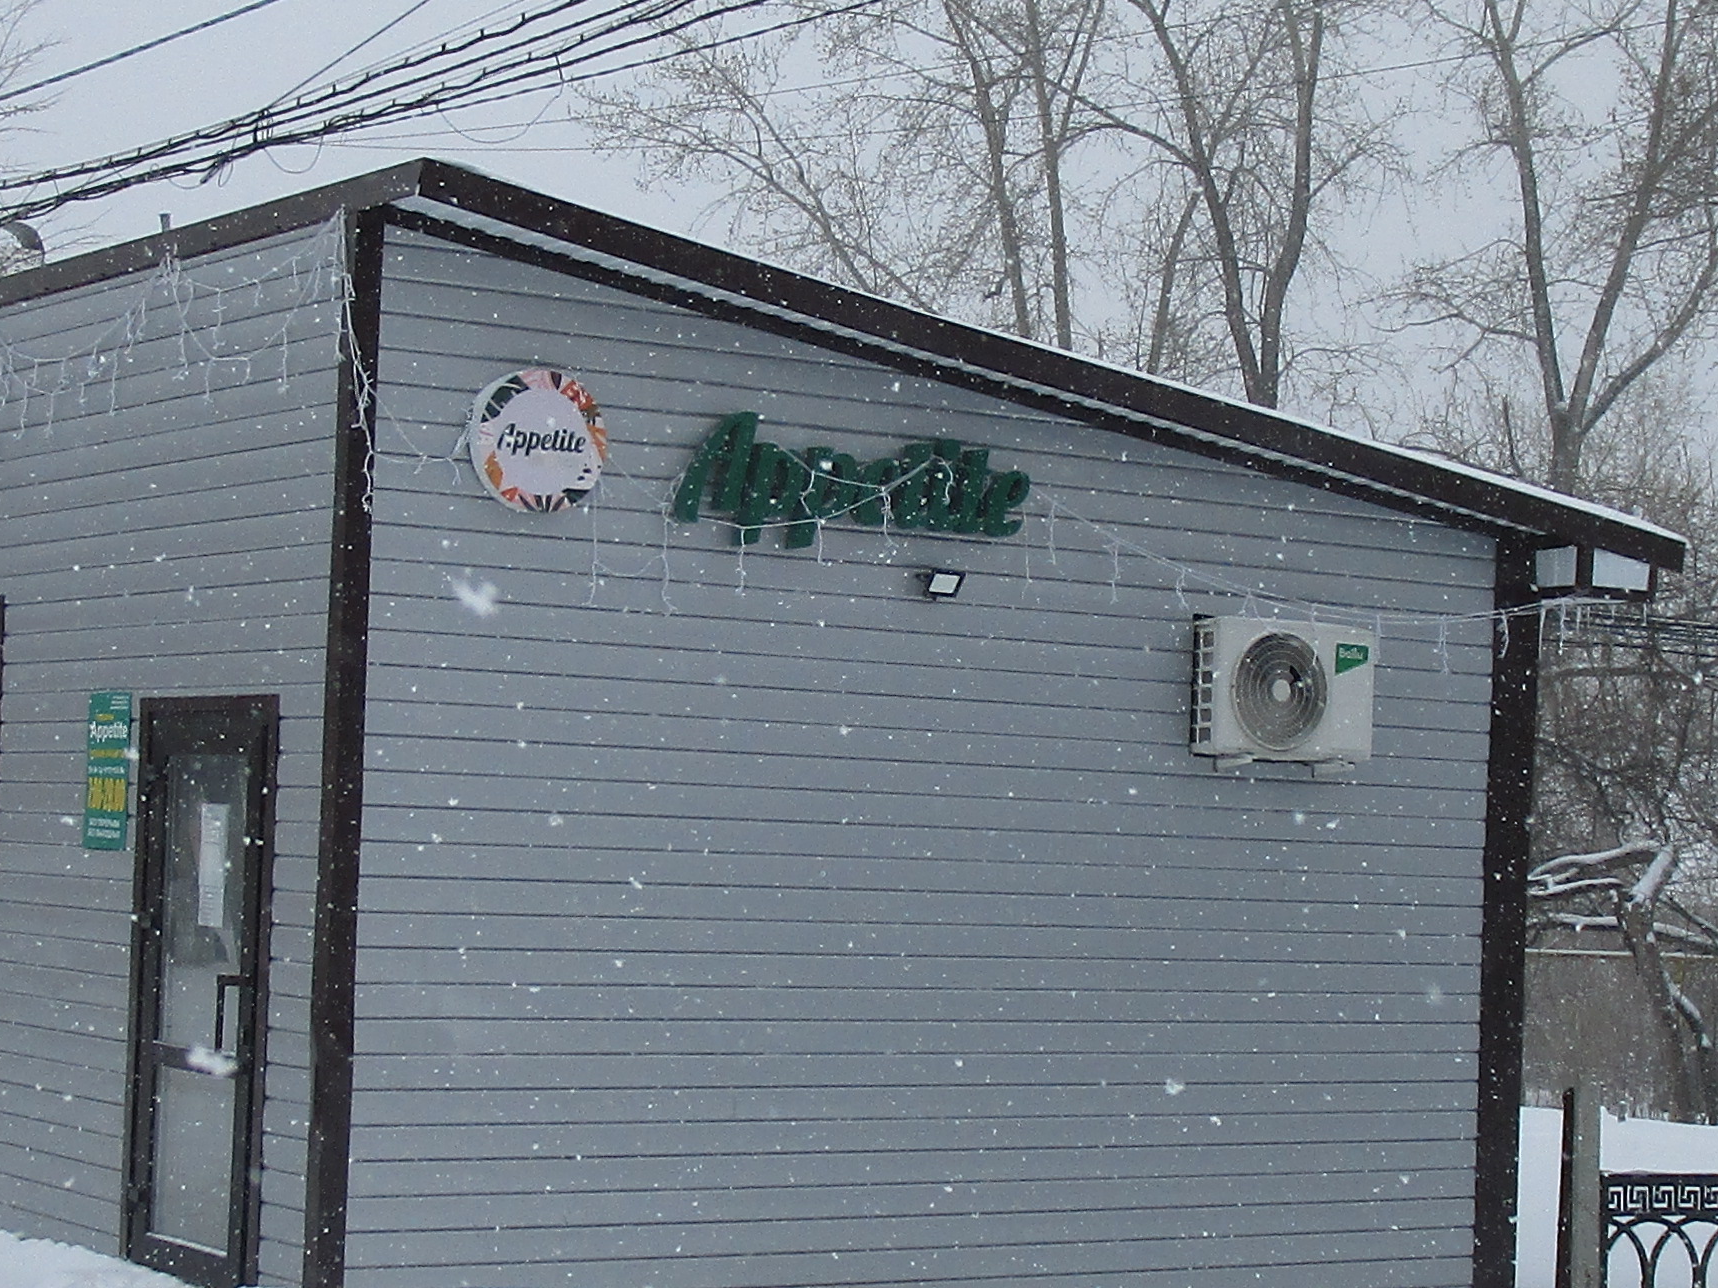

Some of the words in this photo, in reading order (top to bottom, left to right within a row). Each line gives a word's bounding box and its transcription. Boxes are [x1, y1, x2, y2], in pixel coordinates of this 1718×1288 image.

[496, 422, 587, 456] Appetite
[674, 411, 1030, 549] Appetite
[88, 720, 128, 743] Appetite
